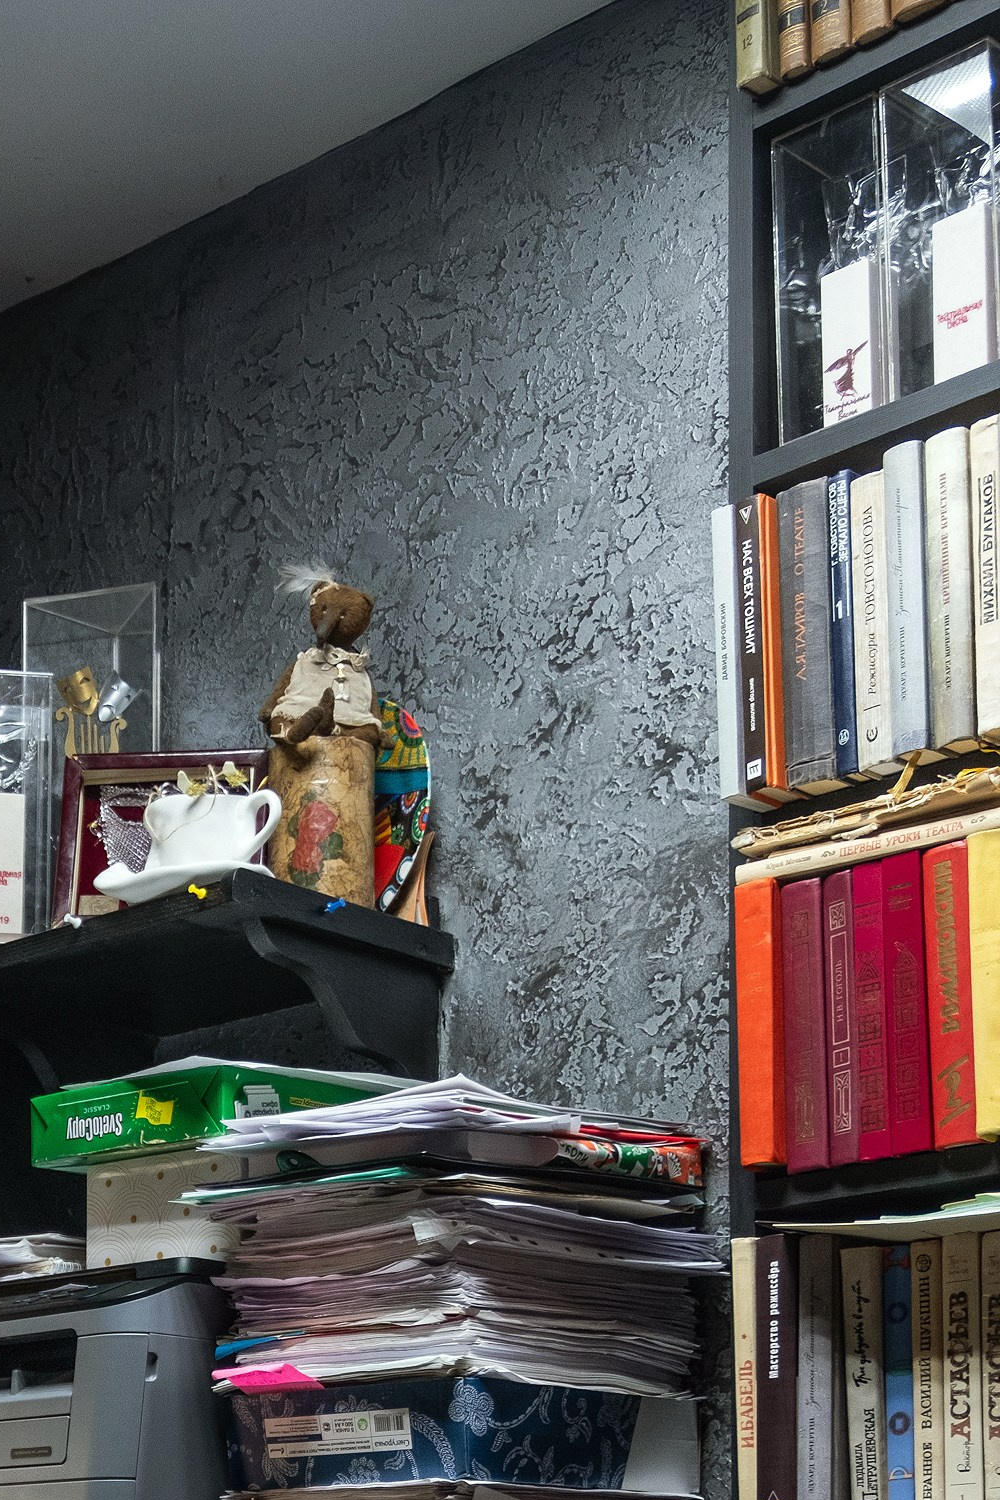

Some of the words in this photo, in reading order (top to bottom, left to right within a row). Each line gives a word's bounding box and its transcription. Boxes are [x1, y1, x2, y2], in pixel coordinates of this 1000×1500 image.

[742, 34, 753, 51] 12
[785, 12, 792, 26] 1
[828, 483, 838, 557] ТОВСТОНОГОВ
[836, 479, 847, 515] СЦЕНЫ
[981, 473, 994, 552] БУЛГАКОВ
[742, 539, 753, 567] НАС
[837, 515, 848, 563] ЗЕРКАЛО
[742, 568, 754, 600] ВСЕХ
[862, 506, 876, 626] ТОВСТОНОГОВА
[835, 600, 843, 620] 1
[982, 557, 995, 625] МИХАИЛ
[743, 599, 756, 655] ТОШНИТ
[867, 631, 879, 695] Режиссура
[838, 839, 882, 858] ПЕРВЫЕ
[886, 831, 921, 848] УРОКИ
[925, 821, 964, 840] ТЕАТРА
[66, 1111, 124, 1142] SvetoCopy
[83, 1103, 111, 1114] CLASSIC
[768, 1260, 780, 1317] режиссёра
[918, 1275, 932, 1352] ШУКШИН
[768, 1318, 780, 1380] Мастерство
[947, 1291, 973, 1442] АСТАФЬЕВ
[739, 1359, 755, 1449] И.БАБЕЛЬ
[919, 1357, 933, 1431] ВАСИЛИЙ
[374, 1438, 410, 1448] Снегурочка
[855, 1442, 864, 1488] ЛЮДМИЛА
[956, 1441, 975, 1473] Виктор
